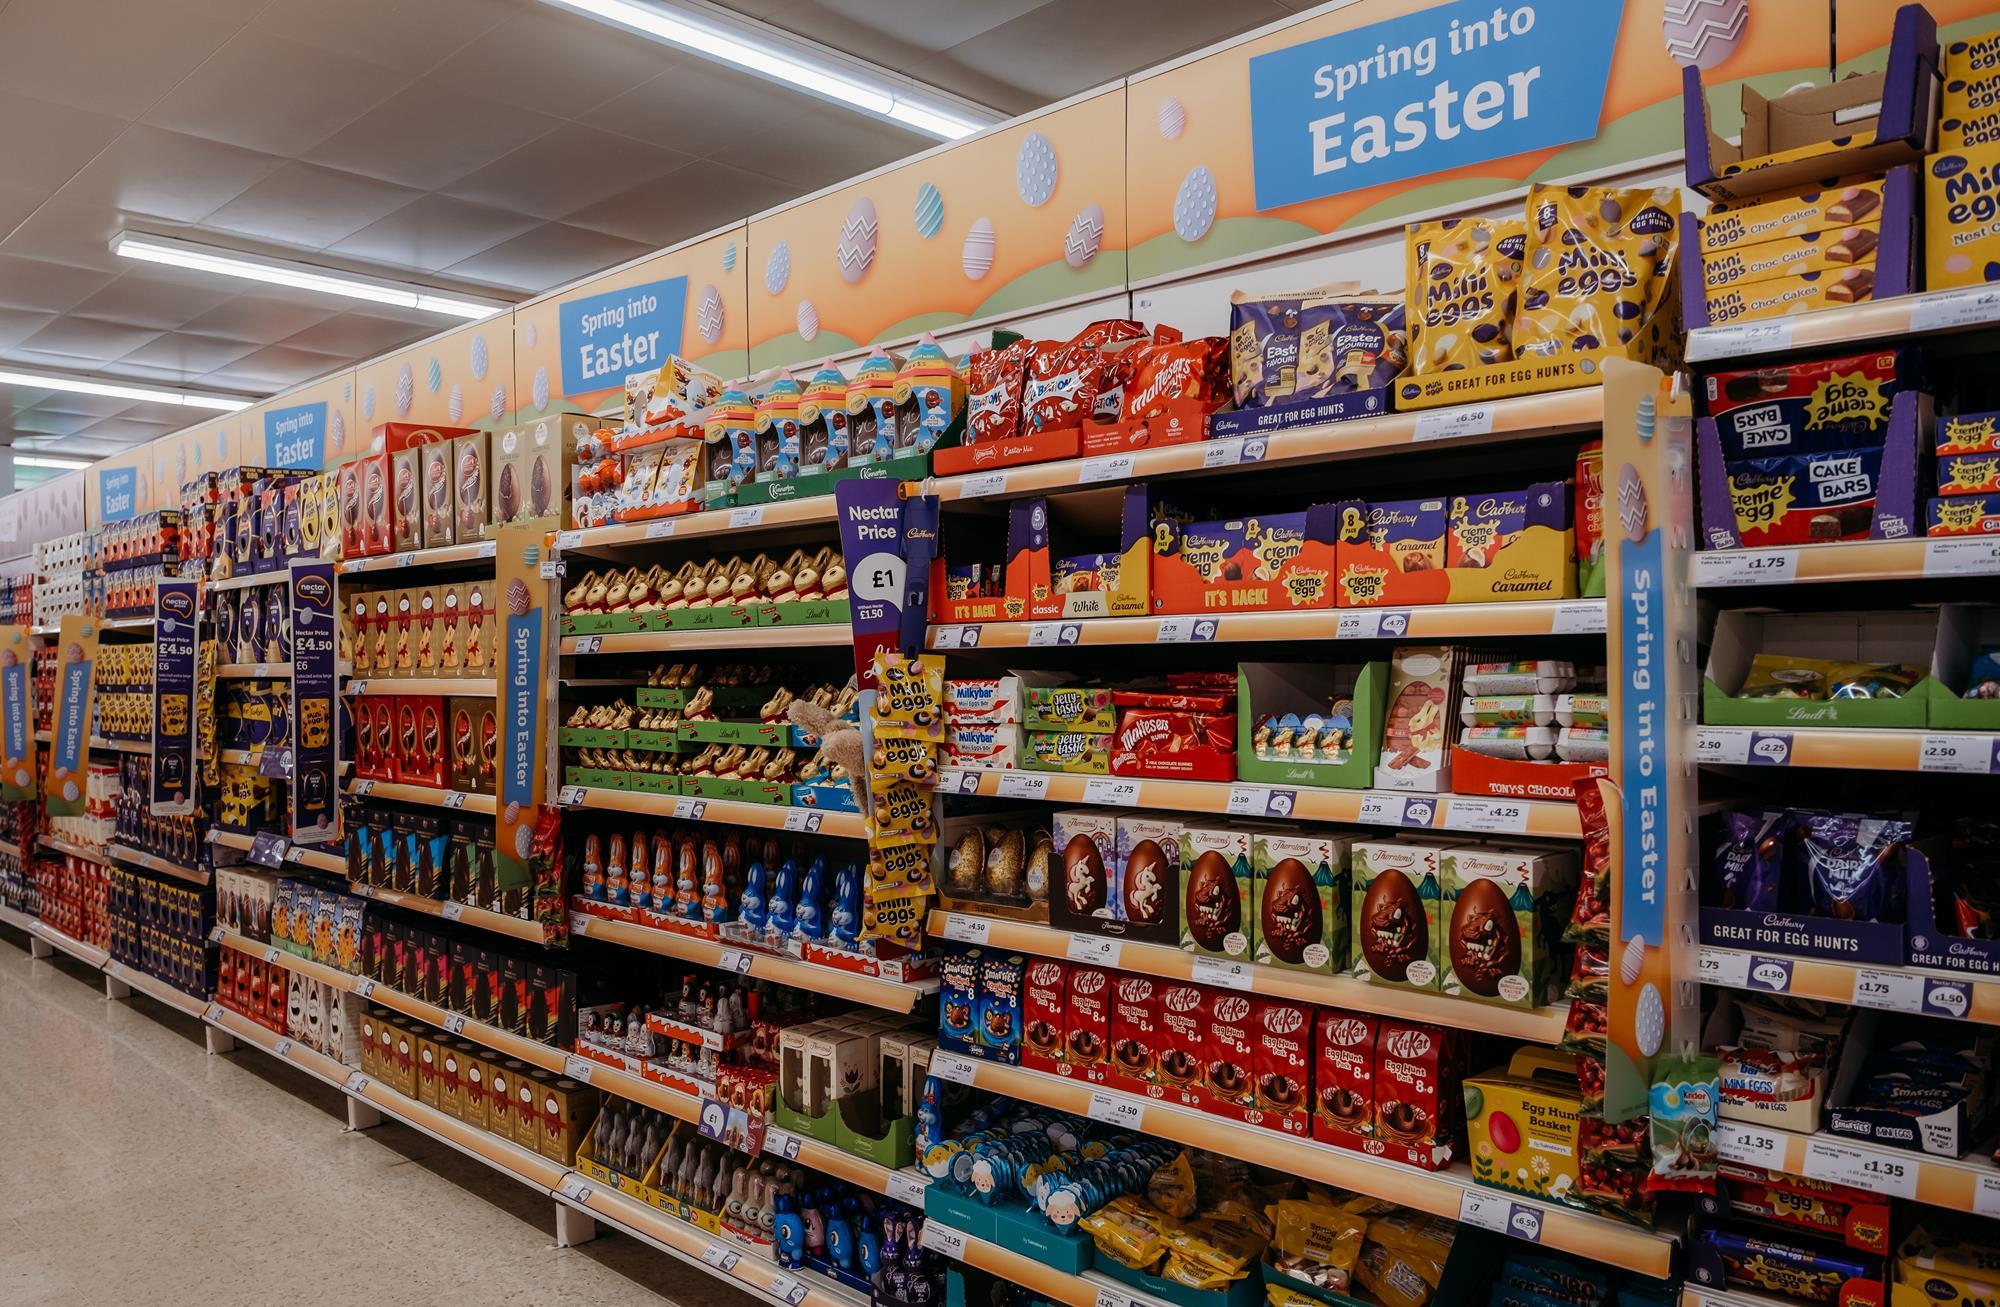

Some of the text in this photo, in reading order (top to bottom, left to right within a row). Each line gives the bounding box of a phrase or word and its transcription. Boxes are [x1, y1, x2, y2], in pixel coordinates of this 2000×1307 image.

[1313, 6, 1536, 100] Spring into
[1309, 66, 1541, 175] Easter
[1706, 214, 1740, 237] Mini
[1707, 207, 1817, 248] eggs Choc Cakes
[1953, 226, 1987, 245] Nest
[1558, 246, 1628, 275] Mini
[1706, 253, 1741, 275] Mini
[1707, 246, 1817, 286] eggs Choc Cakes
[1428, 265, 1487, 306] Mini
[1556, 269, 1638, 297] eggs
[1708, 285, 1818, 323] eggs Choc Cakes
[581, 295, 657, 335] Spring into
[1337, 332, 1381, 345] Easter
[580, 328, 659, 380] Easter
[1448, 364, 1575, 391] GREAT FOR EGG HUNTS
[1131, 357, 1192, 415] Maltesers
[1258, 403, 1344, 426] GREAT FOR EGG HUNTS
[1456, 411, 1484, 424] £6.50
[276, 410, 314, 438] Spring into
[1953, 423, 1987, 434] creme
[275, 436, 315, 467] Easter
[1109, 459, 1129, 468] £5.25
[1812, 462, 1857, 477] CAKE
[1957, 462, 1991, 474] creme
[106, 475, 119, 491] Spring
[1822, 479, 1869, 498] BARS
[106, 493, 130, 514] Easter
[849, 506, 899, 521] Nectar
[1367, 508, 1417, 527] Cadbury
[858, 525, 897, 540] Price
[906, 528, 936, 540] Cadbury
[1159, 530, 1165, 541] 8
[1461, 527, 1494, 539] creme
[1395, 541, 1438, 553] Caramel
[1466, 533, 1487, 547] egg
[1749, 557, 1785, 569] £1.75
[872, 569, 894, 588] £1
[1289, 575, 1322, 589] creme
[1347, 575, 1382, 589] creme
[1492, 580, 1553, 594] Caramel
[166, 598, 188, 606] nectar
[1205, 588, 1268, 606] IT'S BACK!
[1032, 604, 1059, 614] classic
[1073, 601, 1099, 613] White
[1111, 602, 1145, 611] Caramel
[860, 609, 884, 620] £1.50
[1340, 620, 1360, 628] £5.75
[1386, 620, 1404, 628] £4.75
[159, 643, 193, 655] £4.50
[296, 637, 333, 651] £4.50
[158, 662, 170, 671] £6
[296, 661, 308, 671] £6
[889, 680, 927, 697] Mini
[956, 688, 993, 701] Milkybar
[513, 628, 530, 787] Spring into Easter
[891, 691, 933, 711] eggs
[8, 672, 22, 751] Spring into Easter
[66, 670, 82, 760] Spring into Easter
[958, 732, 994, 744] Milkybar
[1121, 718, 1170, 747] Maltesers
[1632, 569, 1660, 904] Spring into Easter
[1760, 742, 1785, 752] £2.25
[1925, 746, 1956, 757] £2.50
[1025, 780, 1043, 788] £1.50
[1114, 785, 1134, 794] £2.75
[887, 784, 918, 807] Mini
[1231, 796, 1249, 805] £3.50
[890, 799, 927, 819] eggs
[1277, 799, 1285, 808] £3
[1362, 804, 1382, 814] £3.75
[1409, 807, 1428, 816] £3.25
[1490, 807, 1519, 818] £4.25
[885, 851, 922, 872] eggs
[1372, 850, 1415, 867] Thorntons
[1462, 861, 1508, 877] Thorntons
[968, 922, 986, 932] £4.50
[1763, 914, 1805, 930] Cadbury
[1713, 924, 1859, 951] GREAT FOR EGG HUNTS
[1101, 943, 1110, 953] £5
[1912, 953, 1989, 970] GREAT FOR EGG
[943, 963, 975, 976] SMARTIES
[1034, 963, 1060, 985] KitKat
[1231, 965, 1240, 975] £5
[1759, 969, 1784, 980] £1.50
[1075, 972, 1105, 993] KitKat
[1858, 983, 1890, 995] £1.75
[1120, 979, 1151, 1002] KitKat
[1009, 996, 1016, 1008] 8
[1072, 996, 1100, 1009] Egg Hunt
[1935, 994, 1963, 1004] £1.50
[1215, 998, 1249, 1022] KitKat
[1266, 1009, 1302, 1032] KitKat
[1328, 1021, 1367, 1045] KitKat
[1388, 1033, 1431, 1057] KitKat
[955, 1064, 972, 1073] £3.50
[1725, 1078, 1773, 1094] MINI EGGS
[1118, 1105, 1137, 1116] £3.50
[1522, 1101, 1580, 1122] Egg Hunt
[709, 1113, 718, 1124] £1
[1529, 1115, 1572, 1134] Basket
[1876, 1127, 1892, 1138] MINI
[1893, 1128, 1913, 1140] EGGS
[1738, 1134, 1774, 1150] £1.35
[1864, 1161, 1904, 1177] £1.35
[909, 1183, 924, 1196] £2.85
[1470, 1203, 1480, 1213] £7
[1515, 1216, 1537, 1229] £6.50
[1816, 1213, 1838, 1226] BAR
[1310, 1222, 1338, 1238] Spring
[944, 1235, 961, 1247] £1.25
[1304, 1238, 1334, 1252] Sweets
